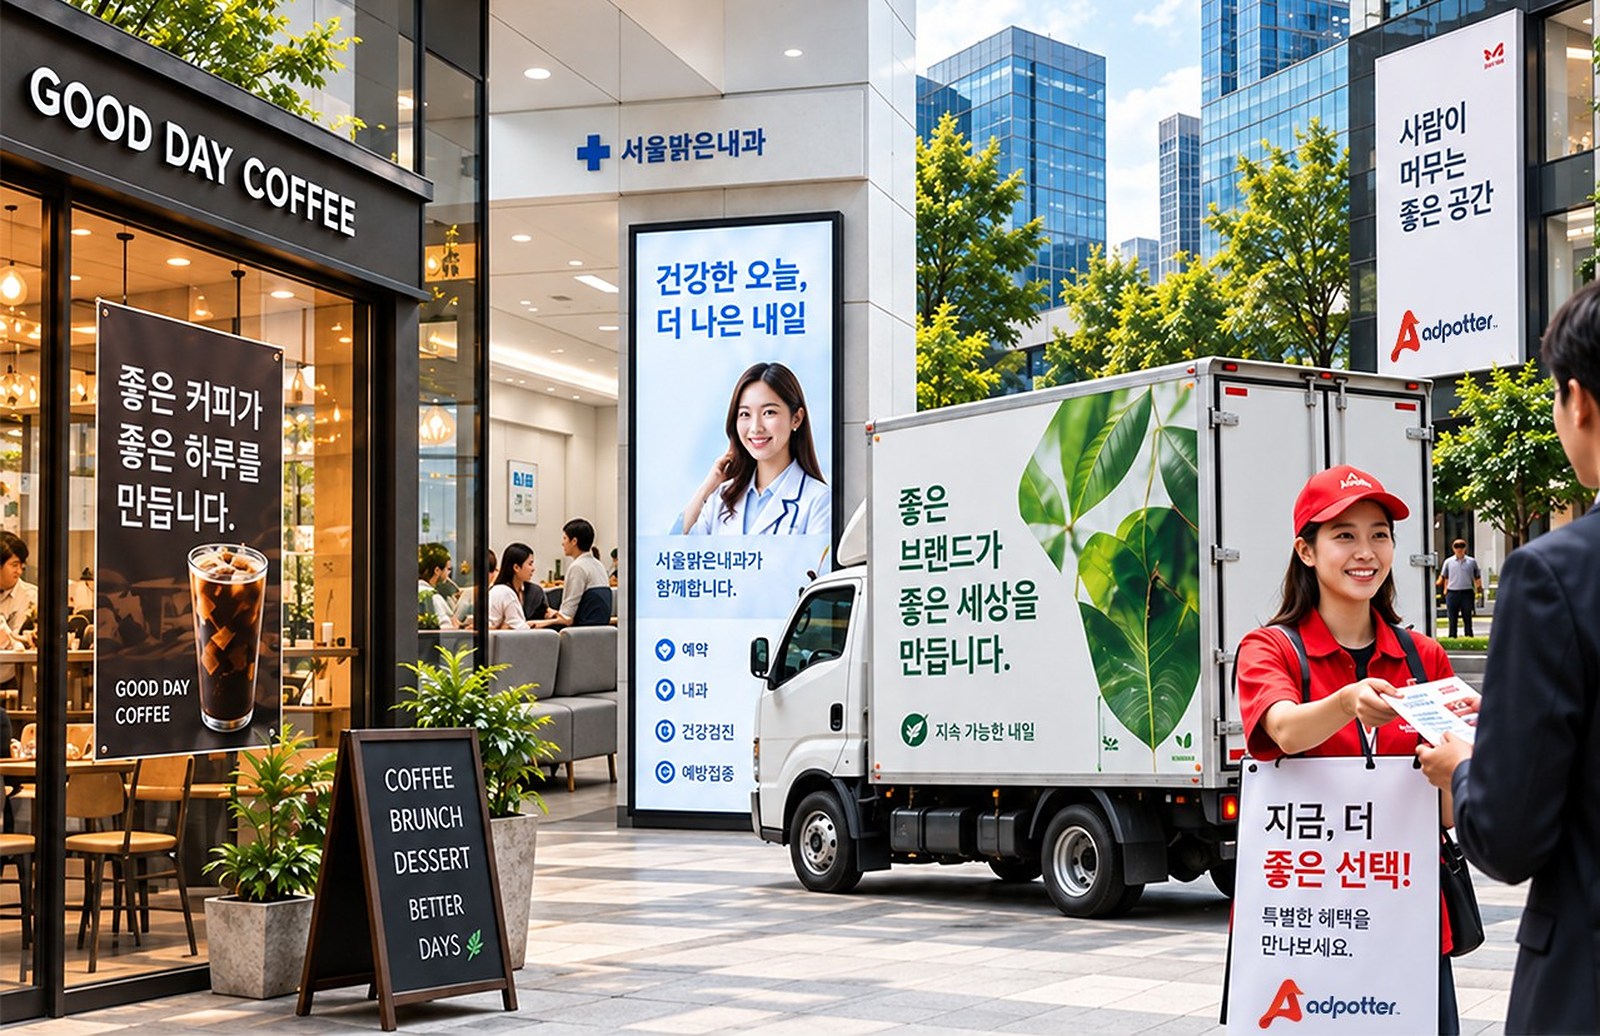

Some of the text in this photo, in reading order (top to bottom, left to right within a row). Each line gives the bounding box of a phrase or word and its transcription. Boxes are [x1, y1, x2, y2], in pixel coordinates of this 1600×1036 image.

[1399, 100, 1466, 147] 사람이
[30, 66, 356, 237] GOOD DAY COFFEE
[1400, 147, 1467, 189] 머무는
[1400, 179, 1494, 232] 좋은 공간
[656, 258, 808, 297] 건강한 오늘,
[657, 301, 807, 340] 더 나은 내일
[1422, 312, 1493, 343] adpotter
[118, 364, 263, 431] 좋은 커피가
[117, 423, 261, 483] 좋은 하루를
[117, 483, 235, 533] 만듭니다.
[898, 484, 949, 526] 좋은
[898, 529, 1003, 573] 브랜드가
[656, 579, 737, 598] 함께합니다.
[898, 579, 1039, 627] 좋은 세상을
[682, 642, 709, 657] 예약
[899, 634, 1011, 676] 만듭니다.
[115, 679, 190, 697] GOOD DAY
[682, 682, 709, 699] 내과
[115, 705, 171, 724] COFFEE
[682, 723, 734, 741] 건강검진
[935, 722, 1035, 741] 지속 가능한 내일
[384, 766, 455, 792] COFFEE
[682, 764, 735, 782] 예방접종
[389, 806, 464, 832] BRUNCH
[1265, 801, 1373, 842] 지금, 더
[393, 846, 471, 875] DESSERT
[1263, 850, 1411, 890] 좋은 선택!
[408, 894, 465, 921] BETTER
[1261, 906, 1313, 928] 특별한
[418, 934, 462, 960] DAYS
[1261, 935, 1353, 957] 만나보세요.
[1306, 996, 1396, 1019] adpotter
